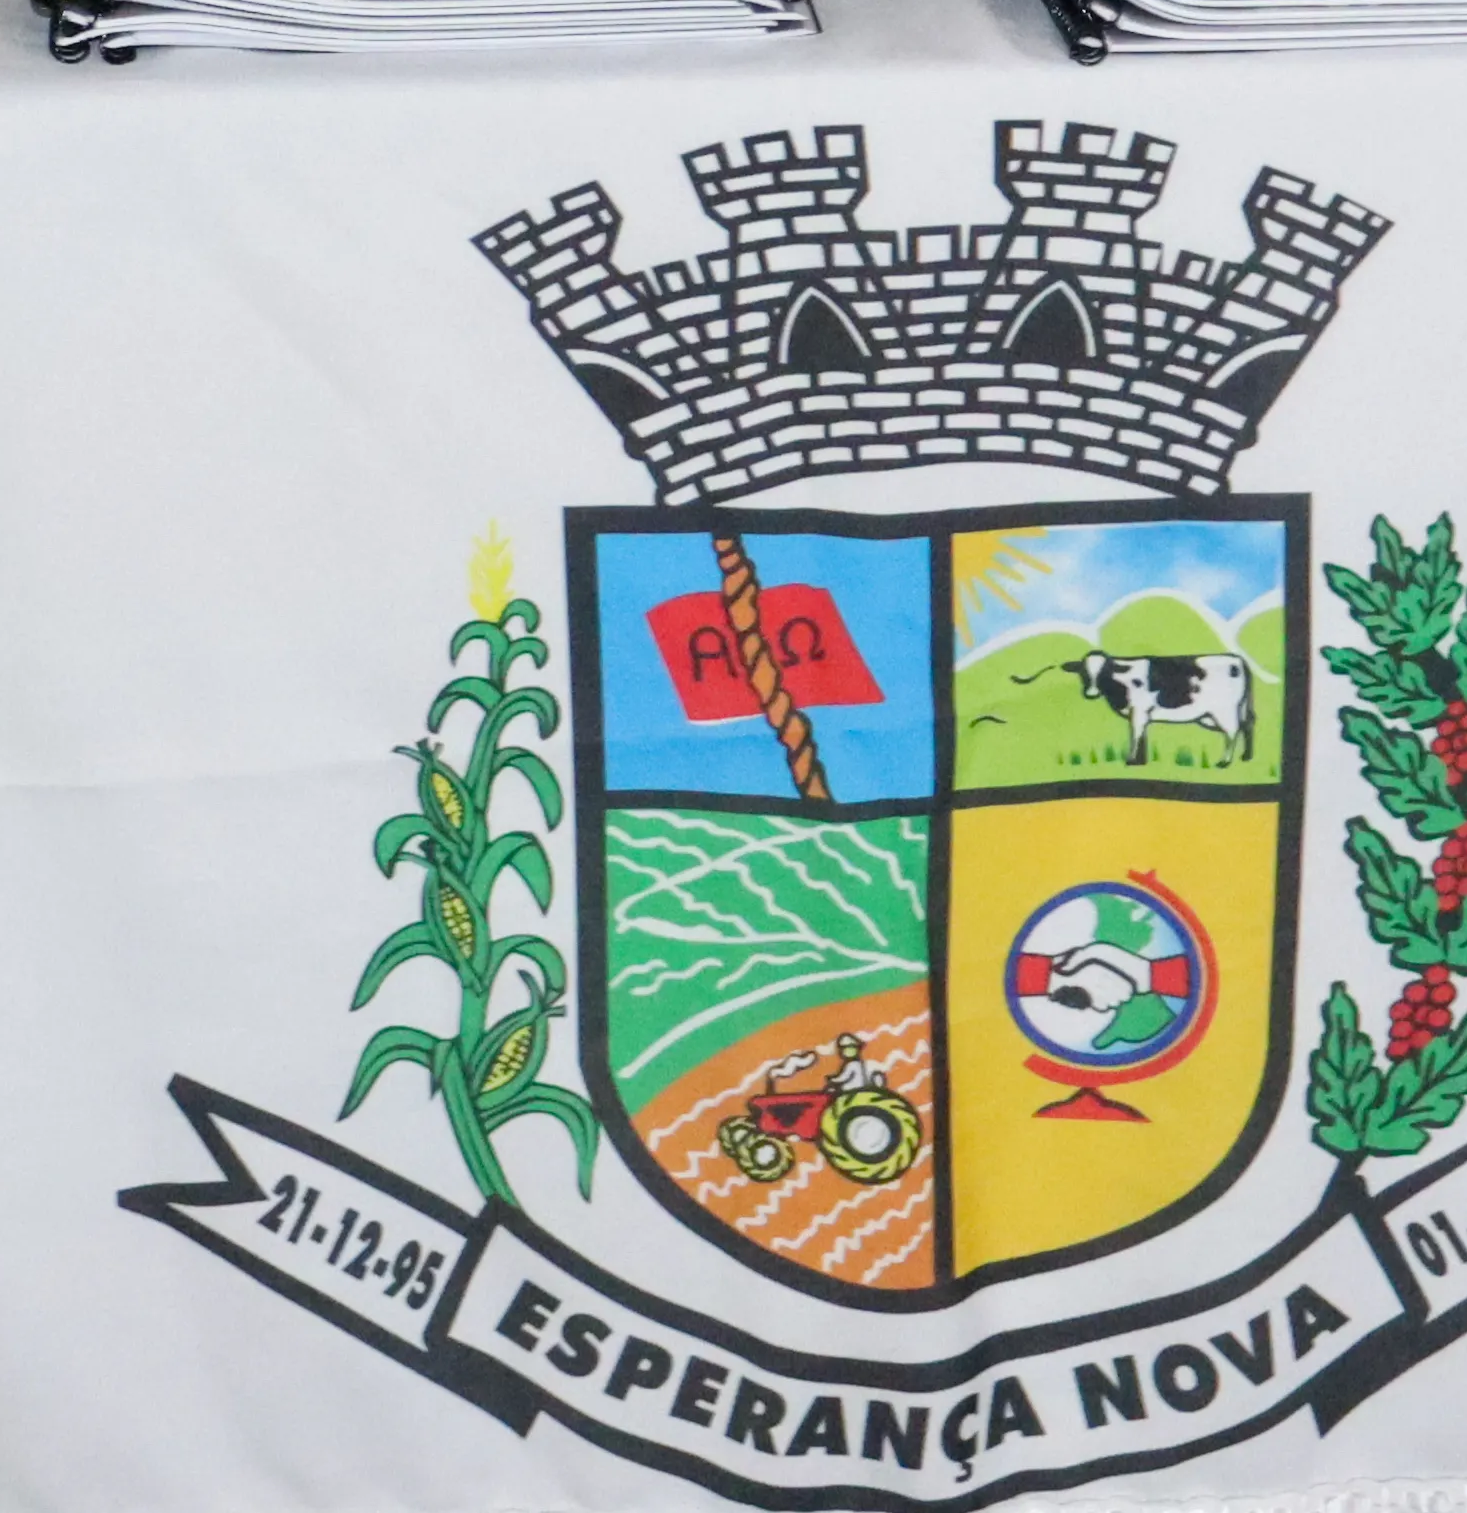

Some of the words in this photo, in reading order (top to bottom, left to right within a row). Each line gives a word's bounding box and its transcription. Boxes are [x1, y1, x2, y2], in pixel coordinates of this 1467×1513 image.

[256, 1173, 446, 1311] 21-12-95
[495, 1279, 1046, 1483] ESPERANÇA
[1072, 1283, 1351, 1429] NOVA
